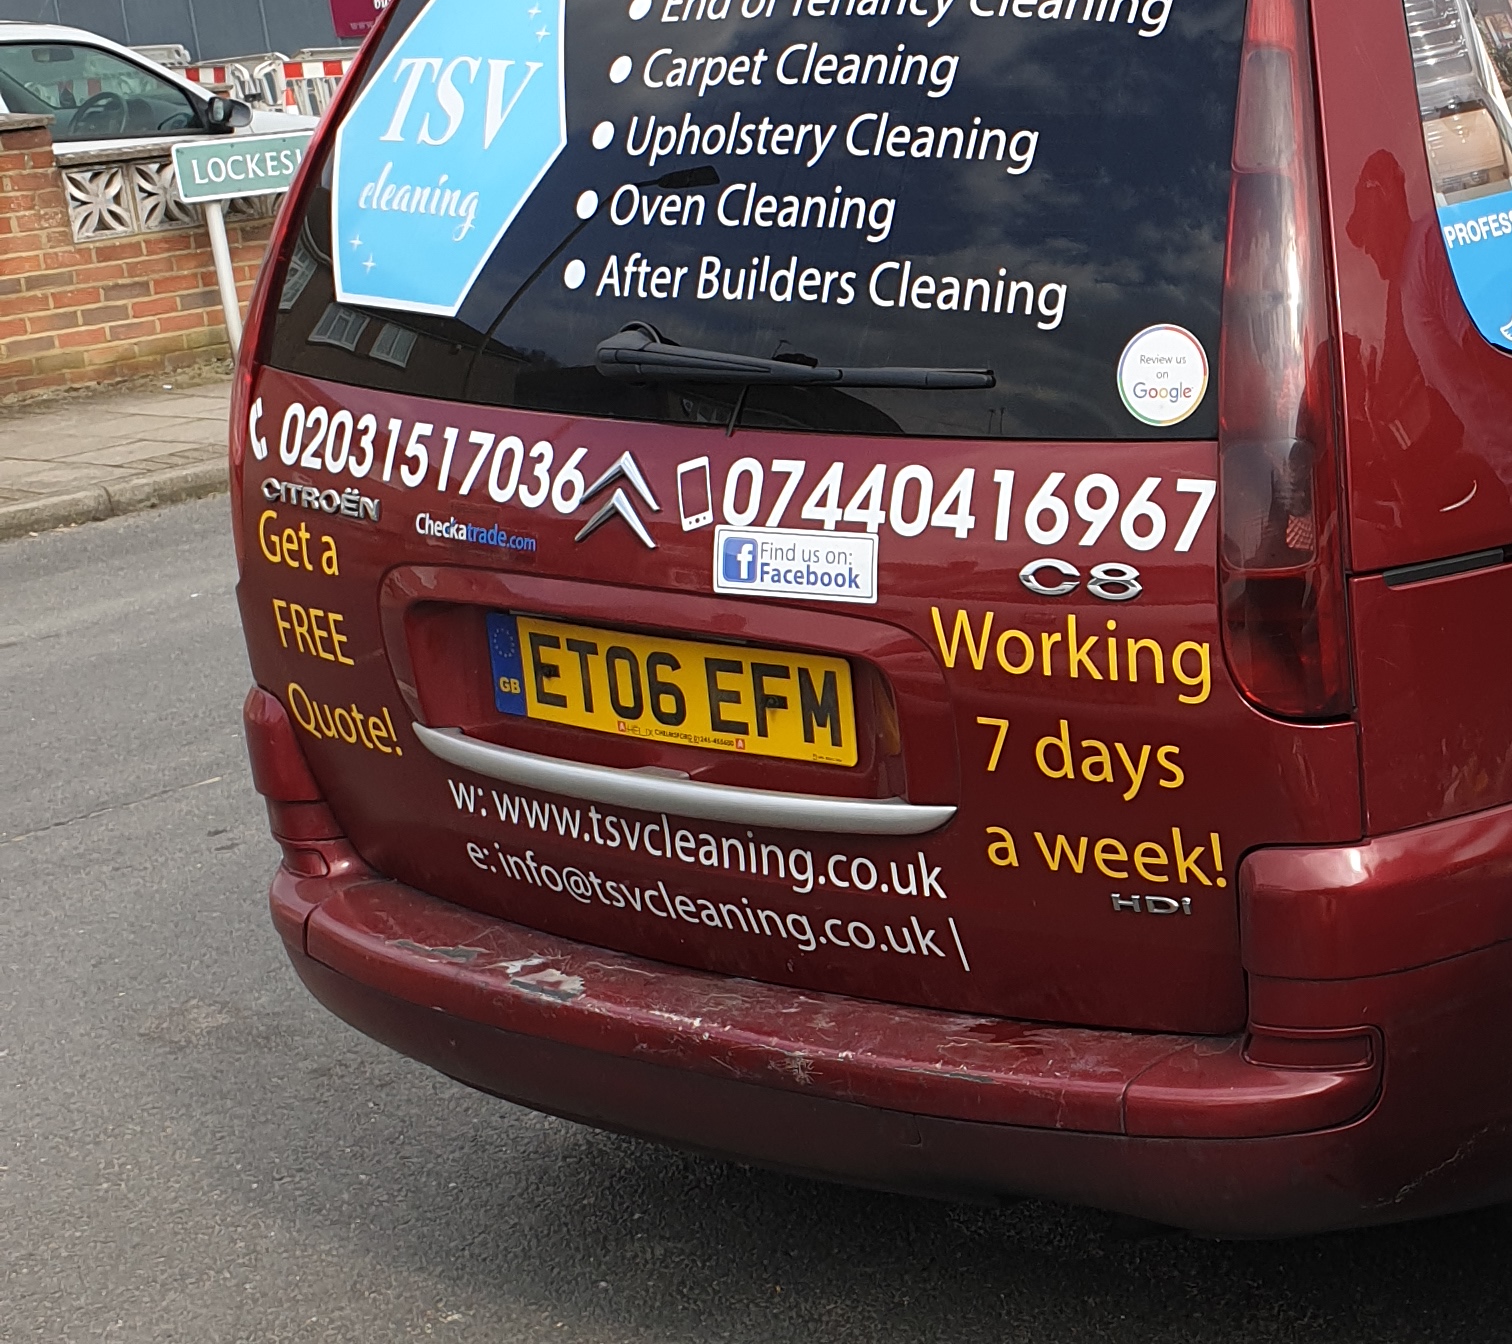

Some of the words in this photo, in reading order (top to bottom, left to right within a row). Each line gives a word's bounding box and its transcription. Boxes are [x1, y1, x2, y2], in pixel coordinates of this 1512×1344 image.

[379, 55, 544, 150] TSV
[642, 47, 768, 97] Carpet
[775, 43, 960, 98] Cleaning
[624, 113, 837, 168] Upholstery
[845, 112, 1040, 175] Cleaning
[358, 161, 480, 242] cleaning
[609, 182, 706, 227] Oven
[716, 182, 896, 243] Cleaning
[597, 256, 689, 305] After
[696, 256, 857, 306] Builders
[867, 260, 1068, 331] Cleaning
[1139, 354, 1173, 364] Review
[1175, 356, 1187, 364] us
[1156, 371, 1169, 379] on
[1133, 382, 1192, 403] Google
[279, 402, 589, 515] 02031517036
[259, 477, 381, 523] CITROËN
[415, 512, 537, 553] Checkatrade.com
[721, 456, 1218, 553] 07440416967
[258, 509, 315, 572] Get
[322, 538, 340, 576] a
[759, 541, 797, 565] Find
[799, 548, 820, 566] us
[823, 549, 855, 568] on:
[759, 561, 861, 591] Facebook
[1018, 558, 1144, 601] C8
[272, 598, 355, 666] FREE
[930, 606, 1214, 705] Working
[499, 676, 521, 696] GB
[528, 631, 687, 727] ET06
[704, 657, 843, 748] EFM
[287, 682, 403, 757] Quote!
[976, 716, 1010, 771] 7
[1034, 719, 1186, 802] days
[491, 789, 948, 900] www.tsvcleaning.co.uk
[985, 826, 1020, 867] a
[1033, 826, 1228, 888] week!
[493, 842, 946, 958] info@tsvcleaning.co.uk
